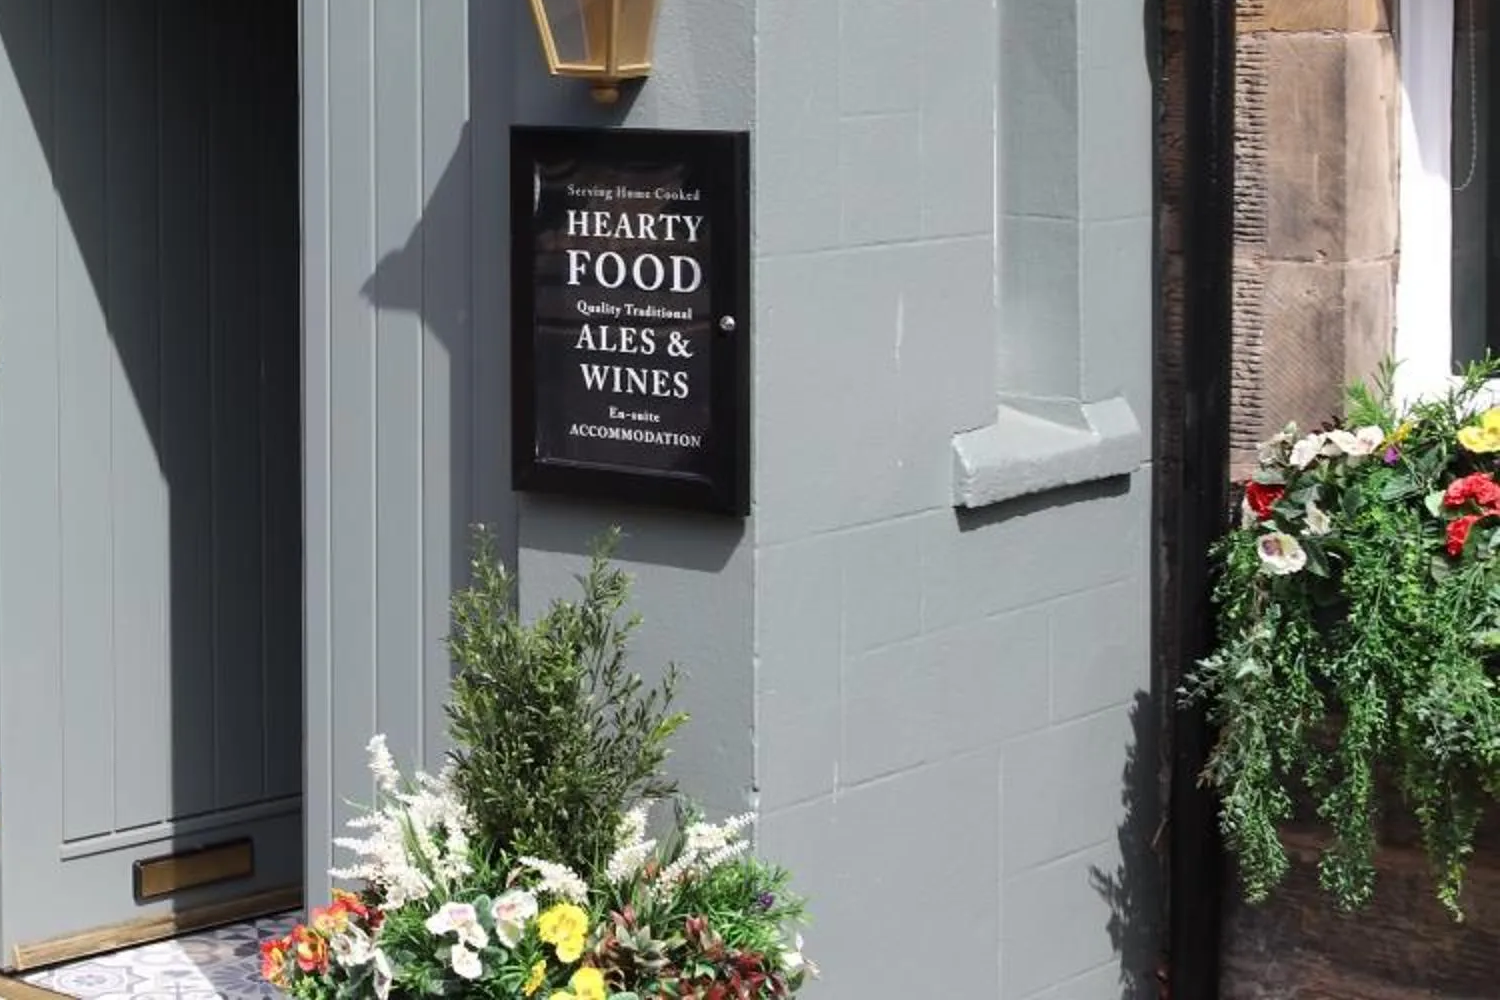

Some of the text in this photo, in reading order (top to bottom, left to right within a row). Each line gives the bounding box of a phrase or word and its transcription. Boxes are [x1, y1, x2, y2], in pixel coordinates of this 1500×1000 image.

[567, 183, 613, 201] Serving
[655, 187, 700, 201] Cooked
[566, 209, 704, 243] HEARTY
[565, 249, 701, 293] FOOD
[577, 300, 693, 320] Quality Traditional
[574, 323, 693, 358] ALES &
[579, 363, 689, 398] WINES
[608, 405, 661, 423] En-suite
[569, 423, 701, 447] ACCOMMODATION
